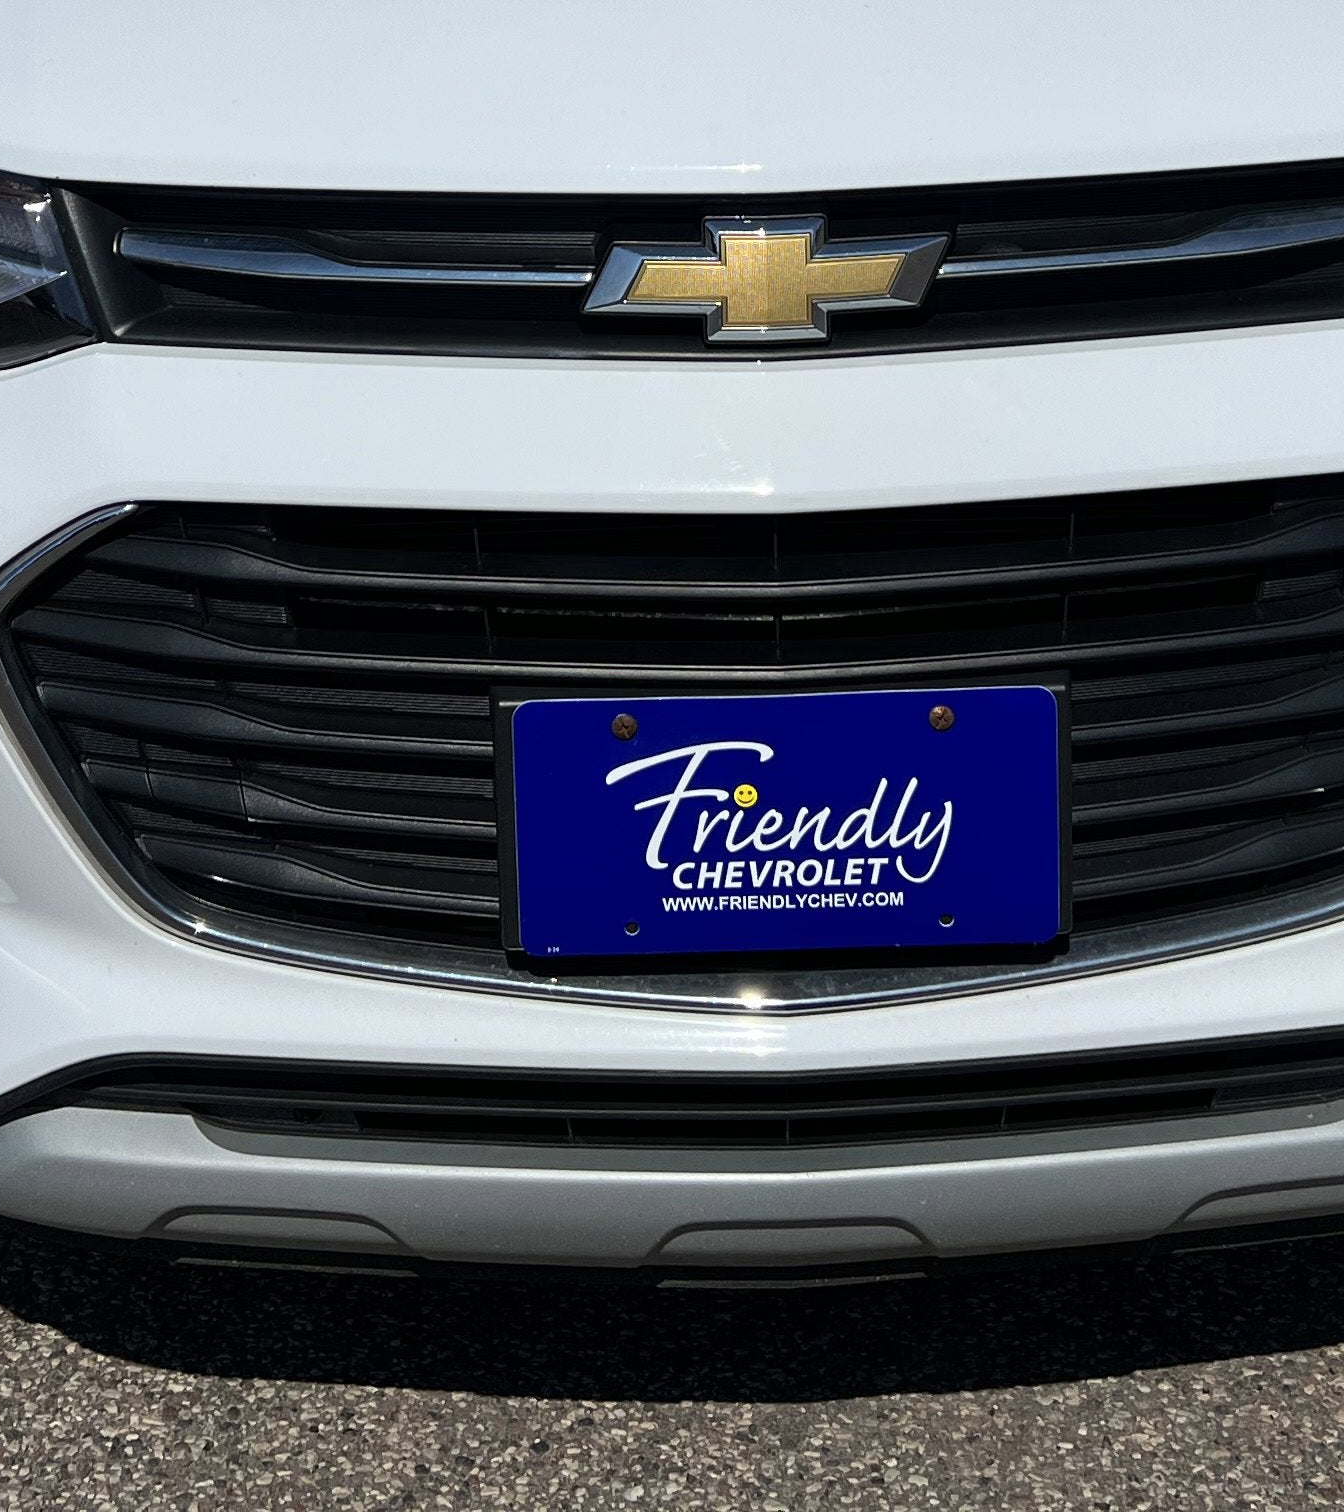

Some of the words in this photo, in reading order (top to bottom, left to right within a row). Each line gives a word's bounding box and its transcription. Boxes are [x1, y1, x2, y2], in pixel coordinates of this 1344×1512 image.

[605, 740, 953, 884] Friendly
[672, 857, 889, 889] CHEVROLET
[662, 891, 905, 912] WWW.FRIENDLYCHEV.COM
